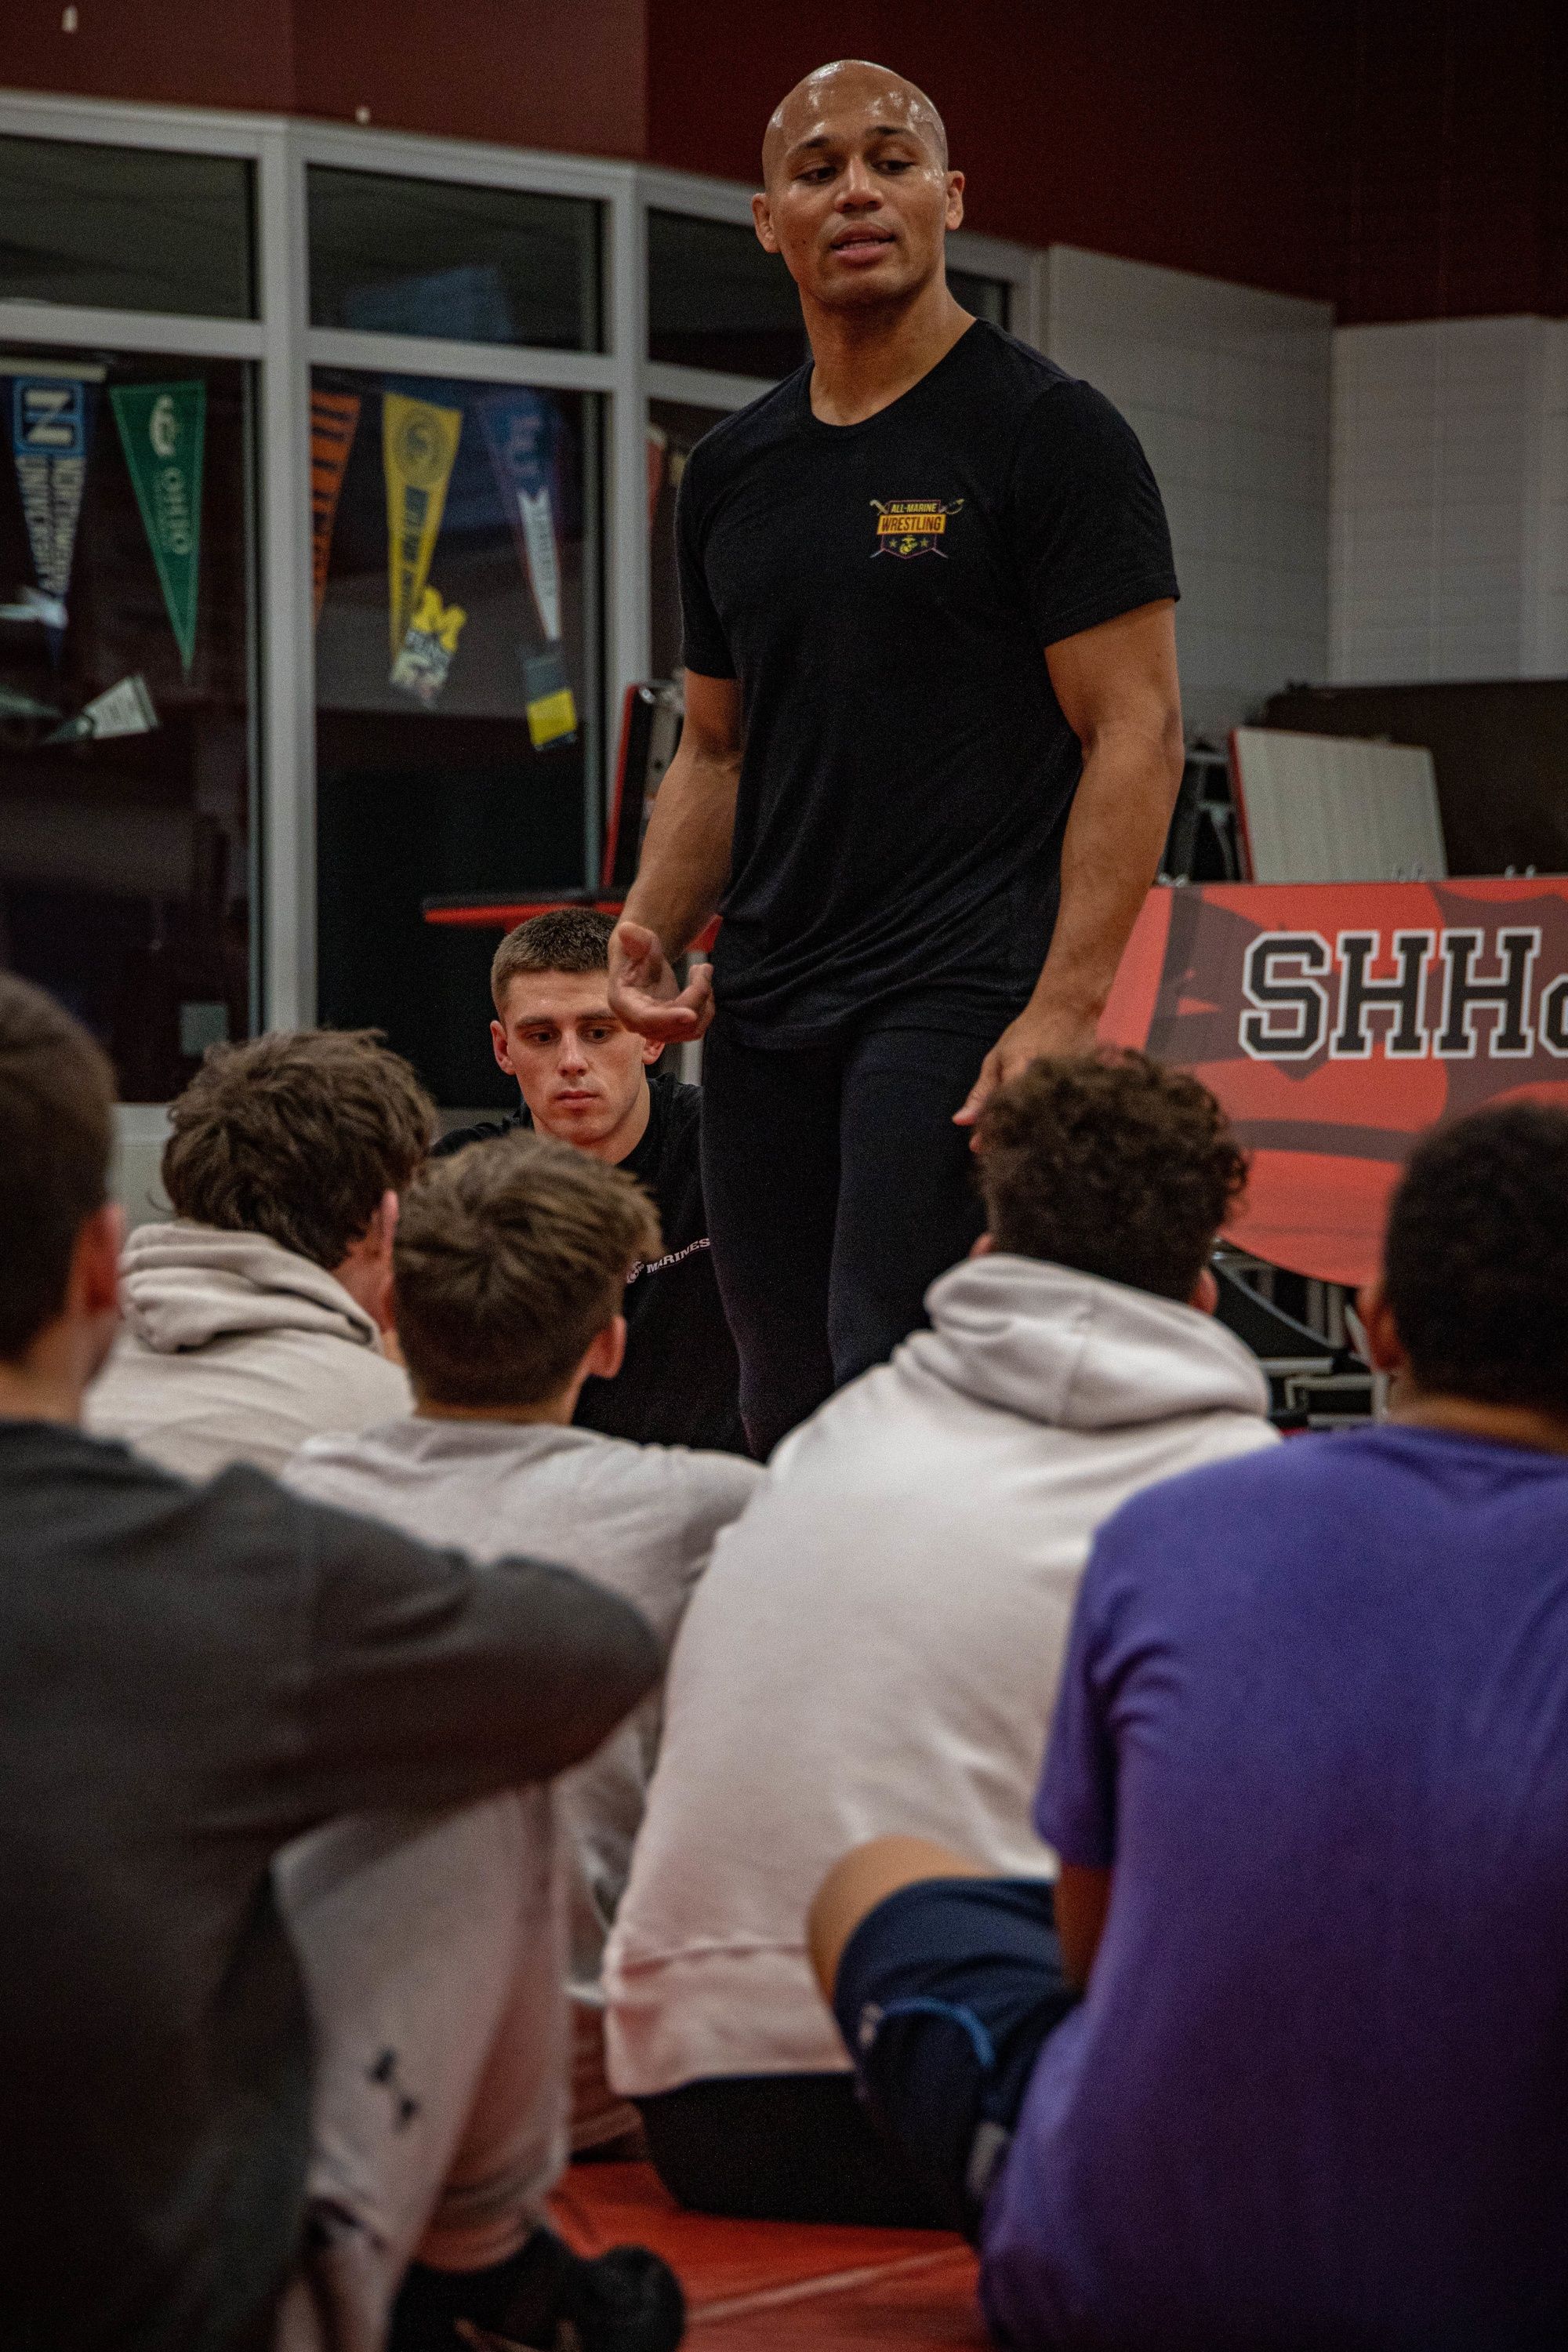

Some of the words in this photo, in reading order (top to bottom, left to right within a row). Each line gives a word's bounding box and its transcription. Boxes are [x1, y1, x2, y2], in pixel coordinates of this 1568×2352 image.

[162, 466, 191, 555] OHIO
[891, 503, 937, 513] ALL-MARINE
[881, 517, 942, 532] WRESTLING
[645, 1238, 711, 1274] MARINES
